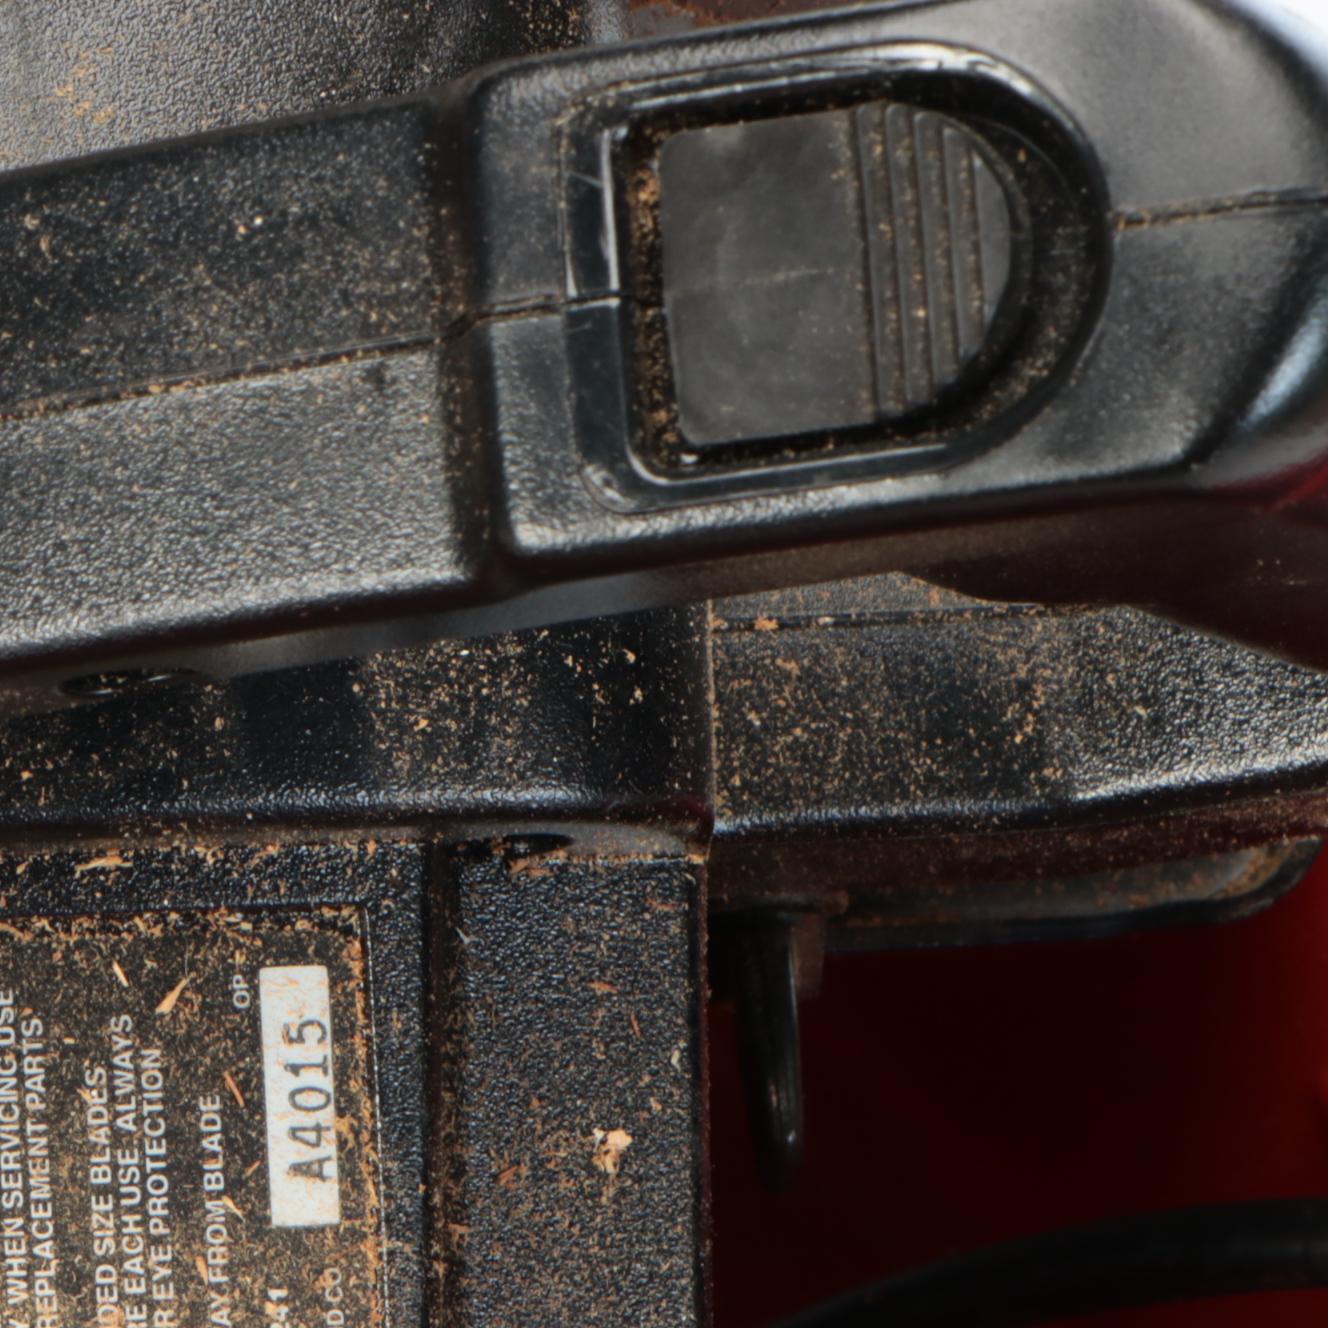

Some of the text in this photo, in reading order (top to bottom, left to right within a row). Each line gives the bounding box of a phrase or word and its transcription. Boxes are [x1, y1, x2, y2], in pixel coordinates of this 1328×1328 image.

[110, 1013, 137, 1131] ALWAYS
[283, 1017, 333, 1184] A4015
[141, 1048, 171, 1235] PROTECTION
[199, 1094, 224, 1190] BLADE
[2, 1217, 28, 1304] WHEN
[91, 1193, 115, 1255] SIZE
[120, 1213, 146, 1294] EACH
[204, 1199, 229, 1282] FROM
[150, 1244, 174, 1300] EYE
